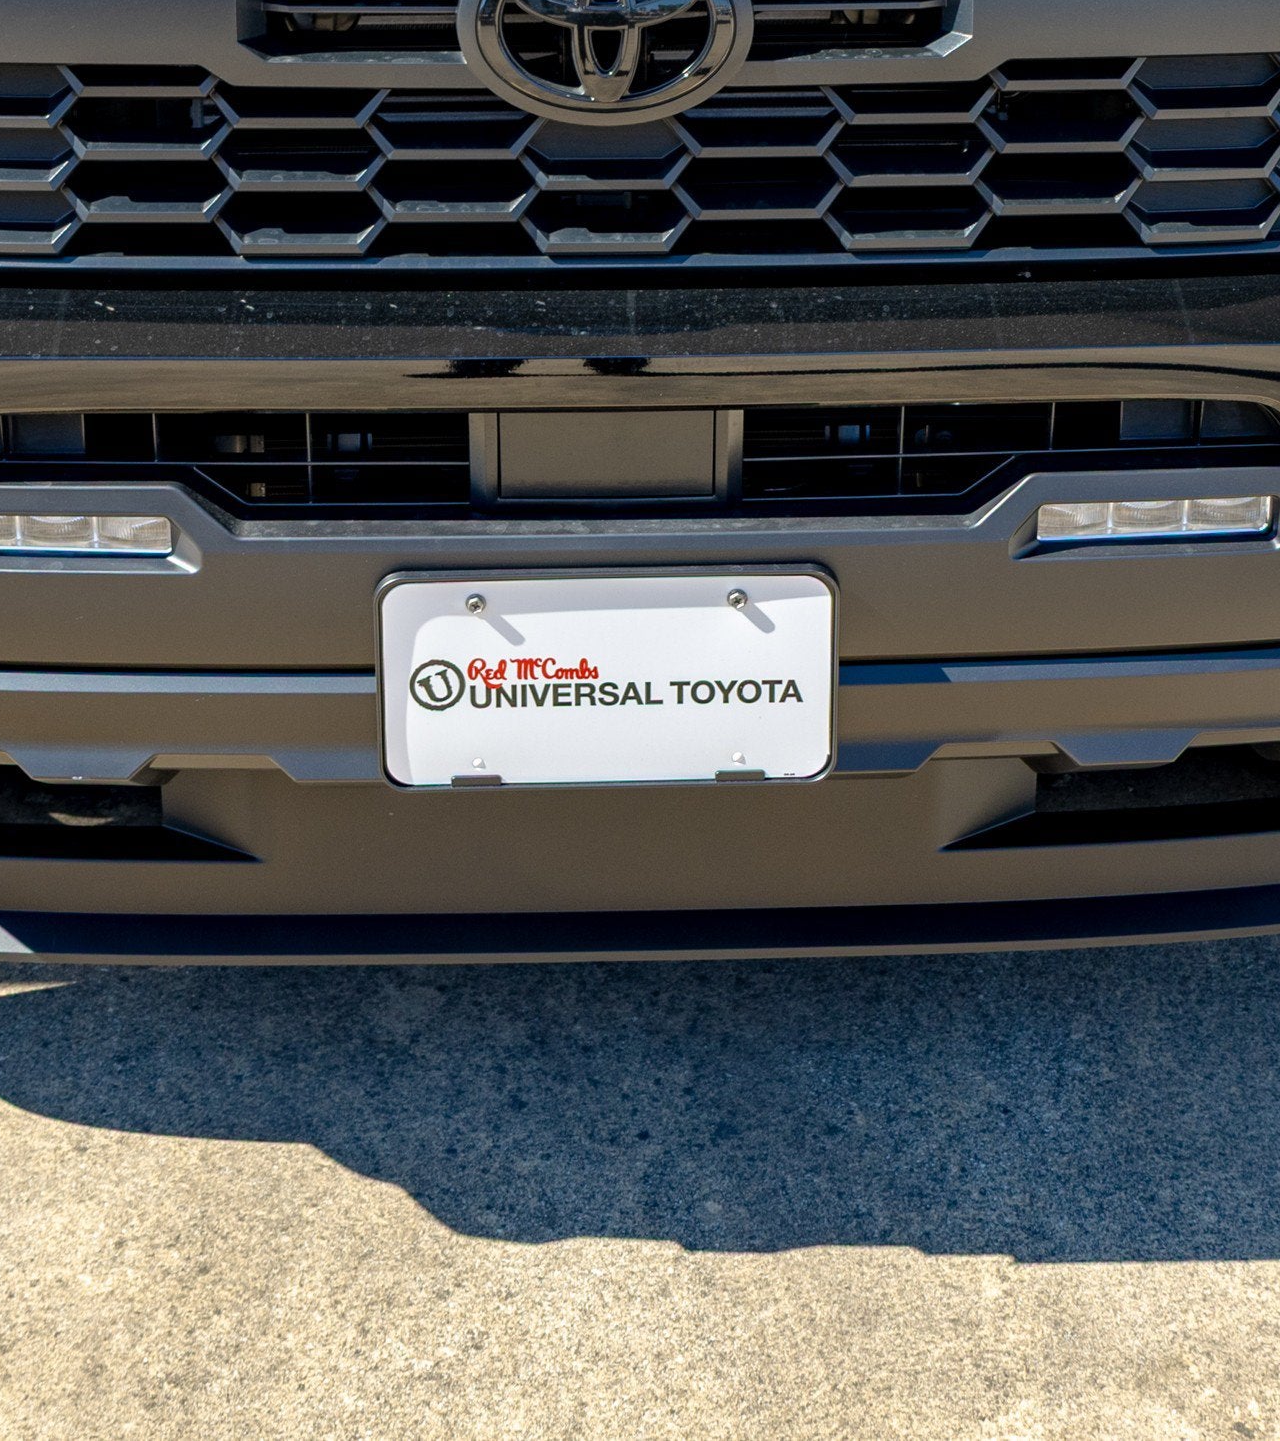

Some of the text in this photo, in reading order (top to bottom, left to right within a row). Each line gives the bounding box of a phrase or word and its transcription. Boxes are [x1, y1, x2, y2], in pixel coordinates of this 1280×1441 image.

[467, 657, 599, 689] Red McCombs
[469, 679, 804, 709] UNIVERSAL TOYOTA
